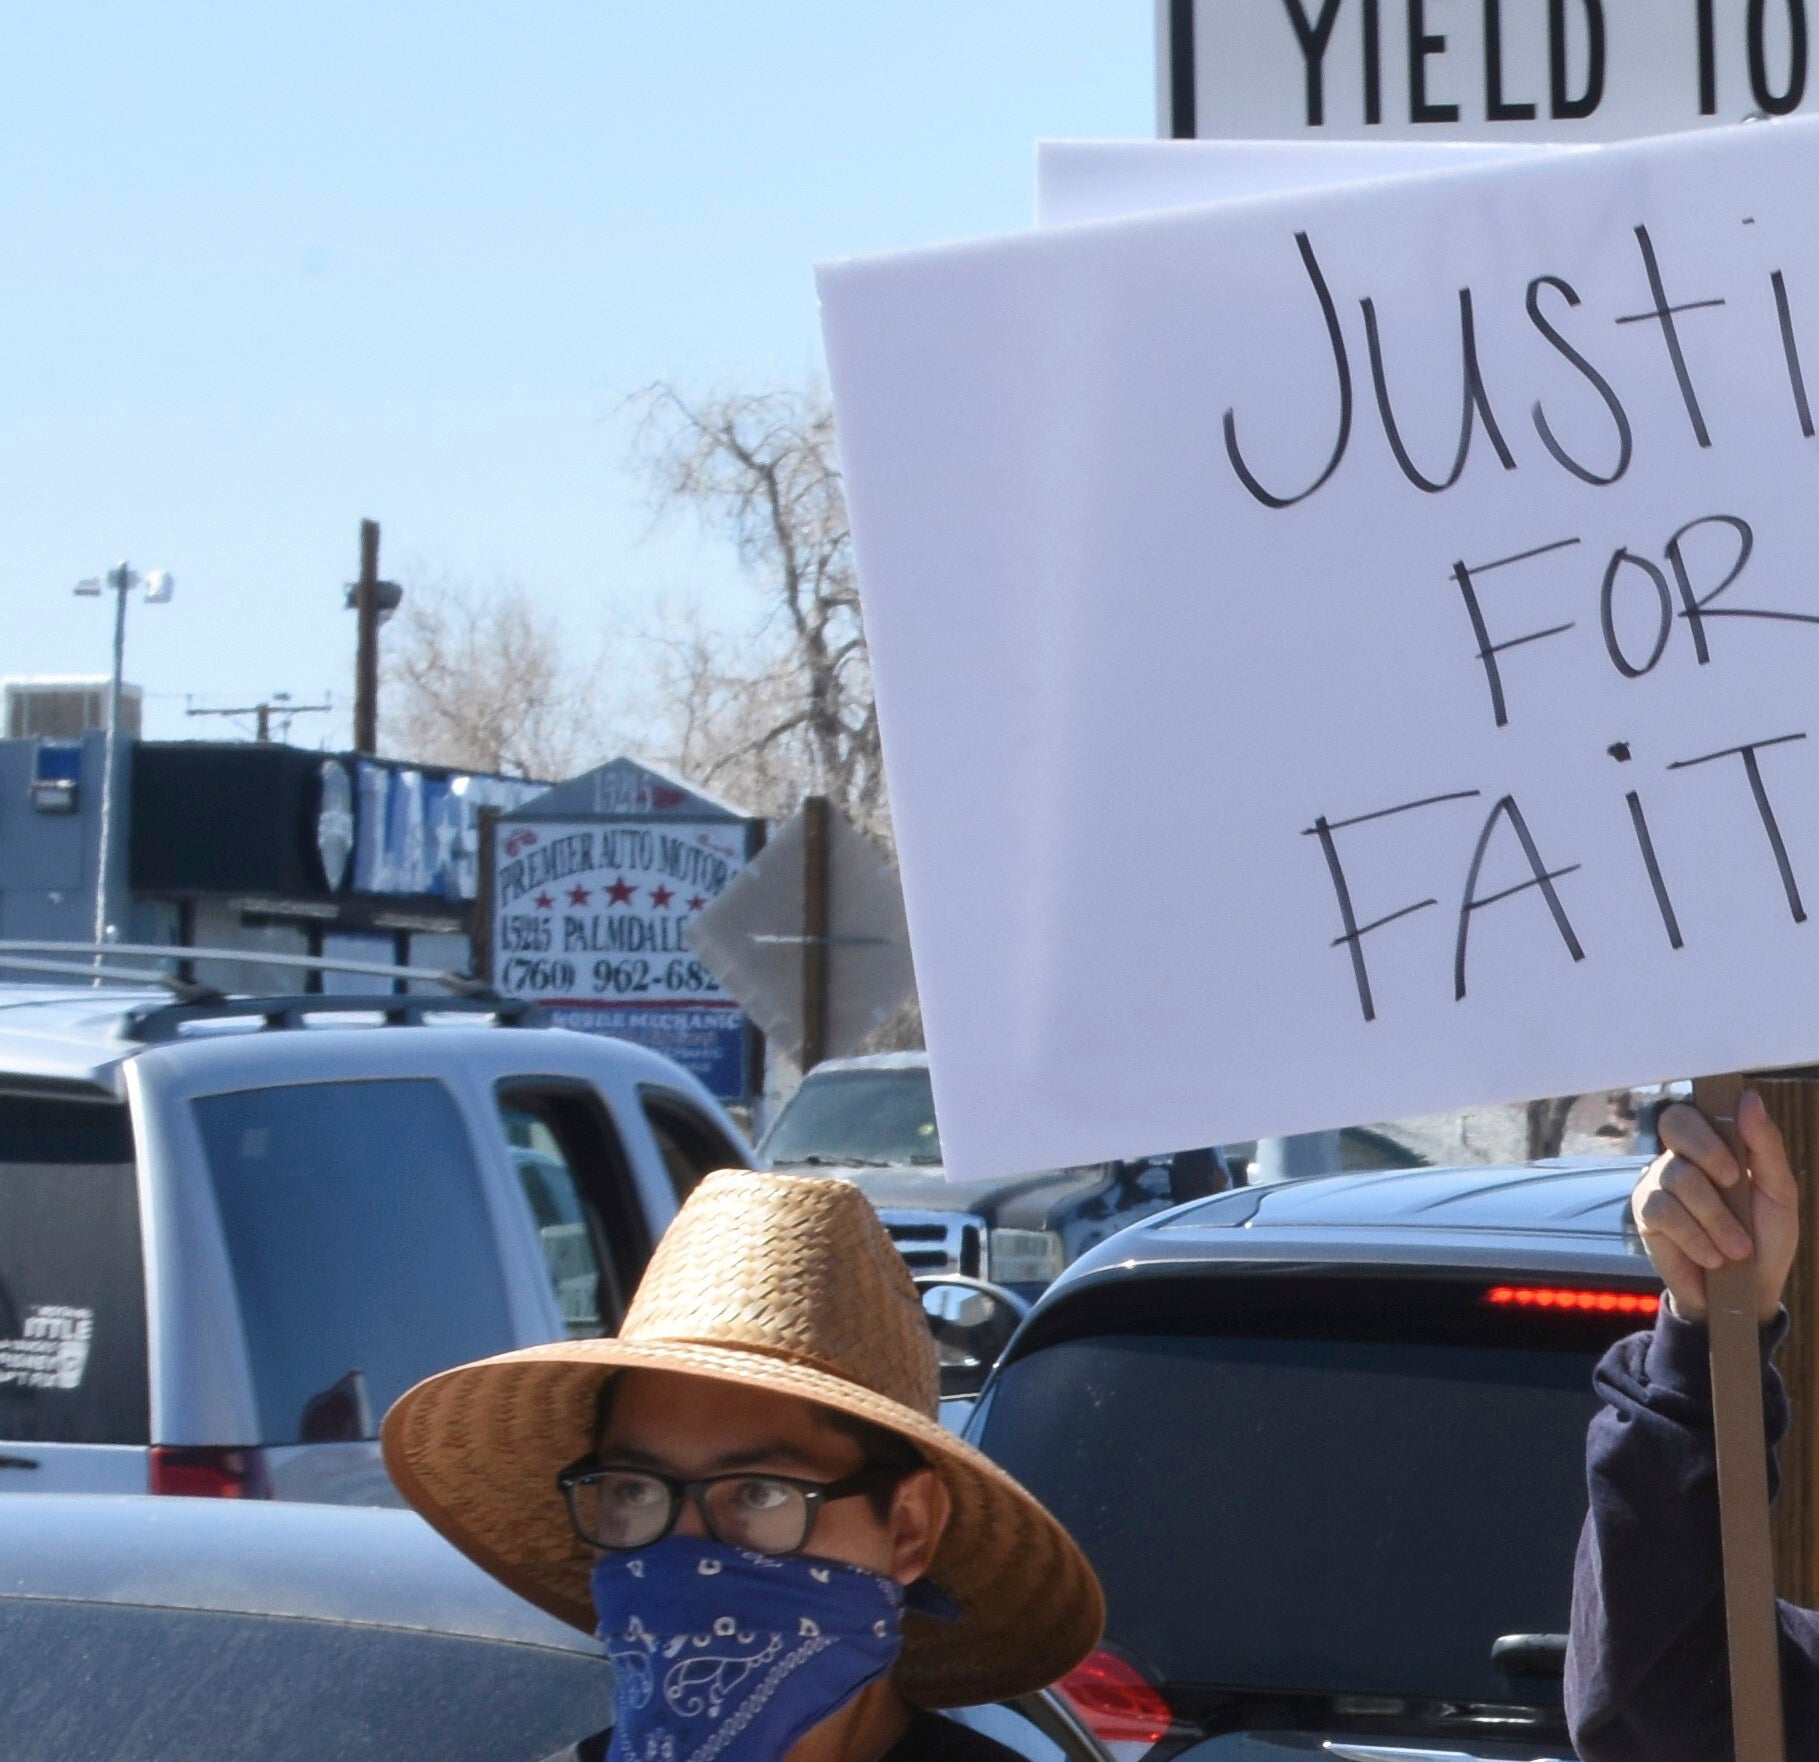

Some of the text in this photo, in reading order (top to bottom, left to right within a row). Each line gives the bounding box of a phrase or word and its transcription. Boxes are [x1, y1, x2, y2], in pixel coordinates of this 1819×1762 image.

[1284, 0, 1607, 126] YIELD
[602, 829, 652, 869] AUTO
[592, 957, 720, 994] 962-682
